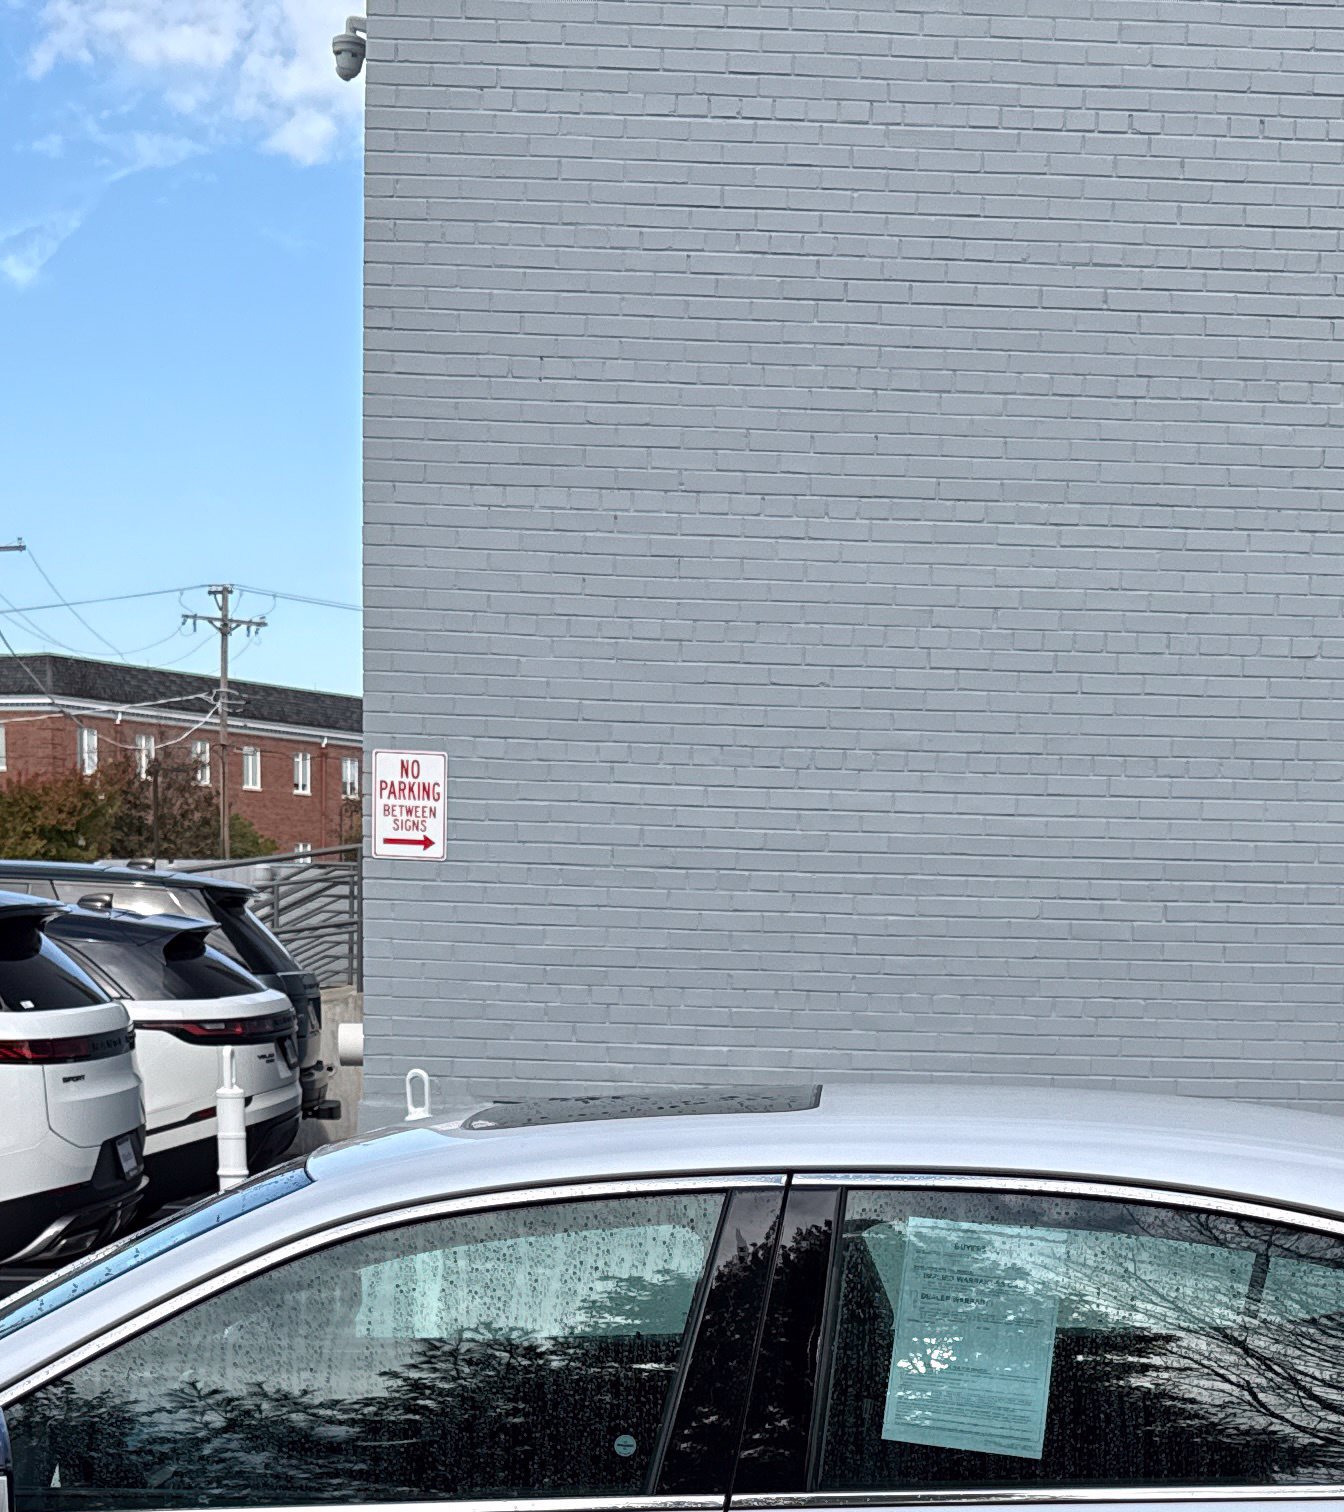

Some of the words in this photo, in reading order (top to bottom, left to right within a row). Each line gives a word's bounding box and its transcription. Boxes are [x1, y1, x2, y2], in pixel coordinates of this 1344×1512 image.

[400, 759, 420, 779] NO
[379, 780, 441, 802] PARKING
[383, 804, 437, 819] BETWEEN
[392, 818, 427, 832] SIGNS
